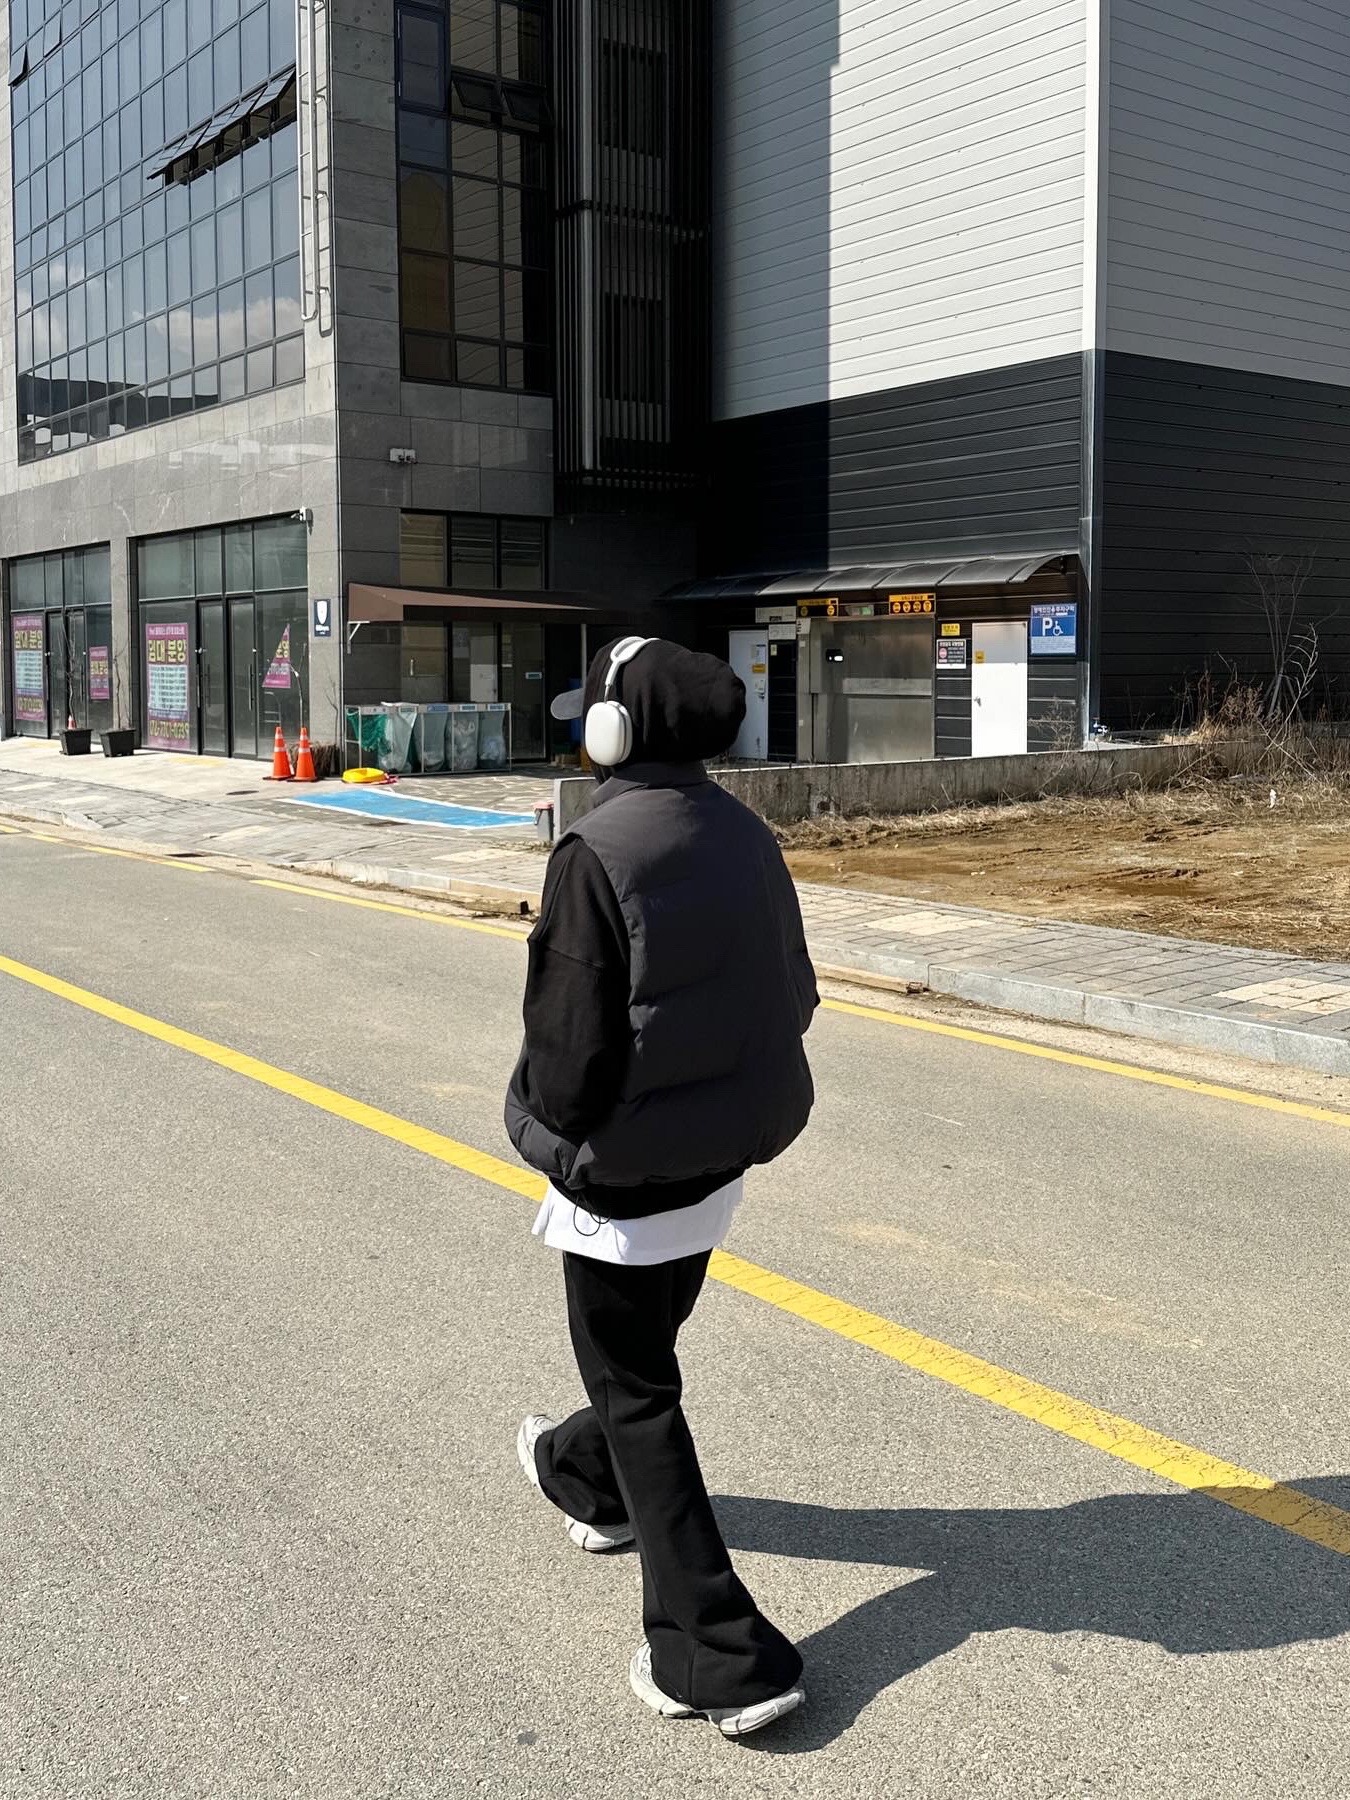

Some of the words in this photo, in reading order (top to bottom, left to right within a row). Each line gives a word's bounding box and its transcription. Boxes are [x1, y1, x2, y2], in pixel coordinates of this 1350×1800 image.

[1042, 617, 1053, 636] P
[148, 640, 166, 662] 임대
[167, 640, 187, 662] 분양
